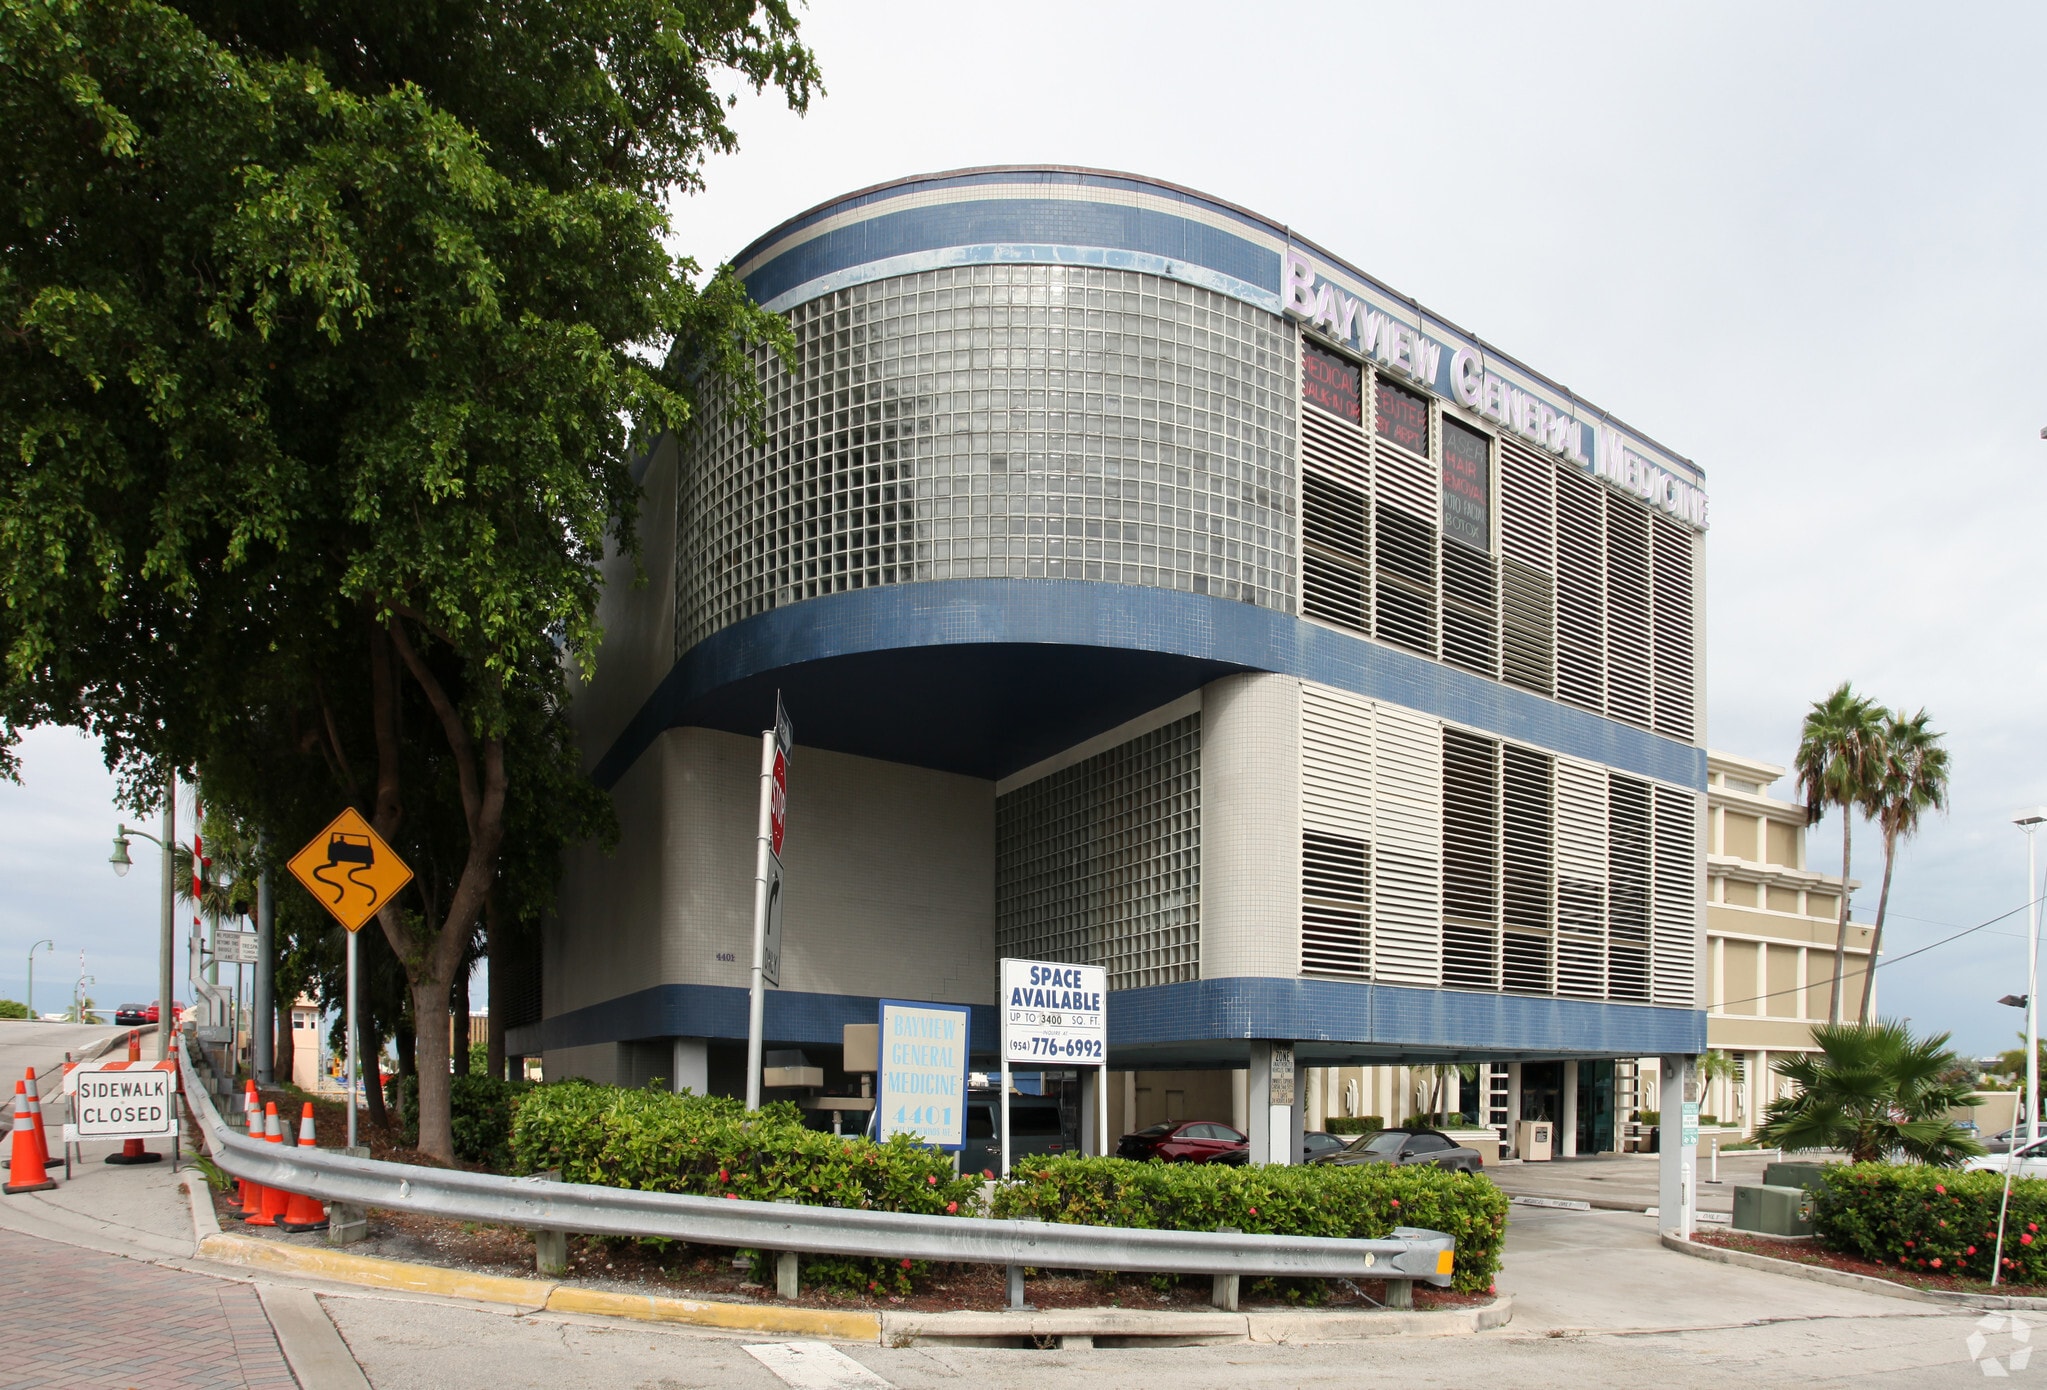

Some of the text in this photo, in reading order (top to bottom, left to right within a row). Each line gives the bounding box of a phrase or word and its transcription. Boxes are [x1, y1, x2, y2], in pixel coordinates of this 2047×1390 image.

[1282, 248, 1711, 534] BAYVIEW GENERAL MEDICINE
[1443, 432, 1485, 462] ASER
[1446, 449, 1477, 479] HAIR
[1445, 512, 1480, 538] BOTOX
[772, 775, 786, 829] STOP
[1030, 965, 1082, 989] SPACE
[1011, 987, 1100, 1011] AVAILABLE
[894, 1014, 956, 1040] BAYVIEW
[1010, 1012, 1101, 1026] UP TO 3400 SQ. FT.
[892, 1043, 956, 1068] GENERAL
[1010, 1037, 1102, 1058] (954) 776-6992
[1275, 1051, 1290, 1061] ZONE
[81, 1082, 164, 1098] SIDEWALK
[888, 1071, 957, 1096] MEDICINE
[83, 1106, 162, 1123] CLOSED
[892, 1104, 952, 1126] 4401
